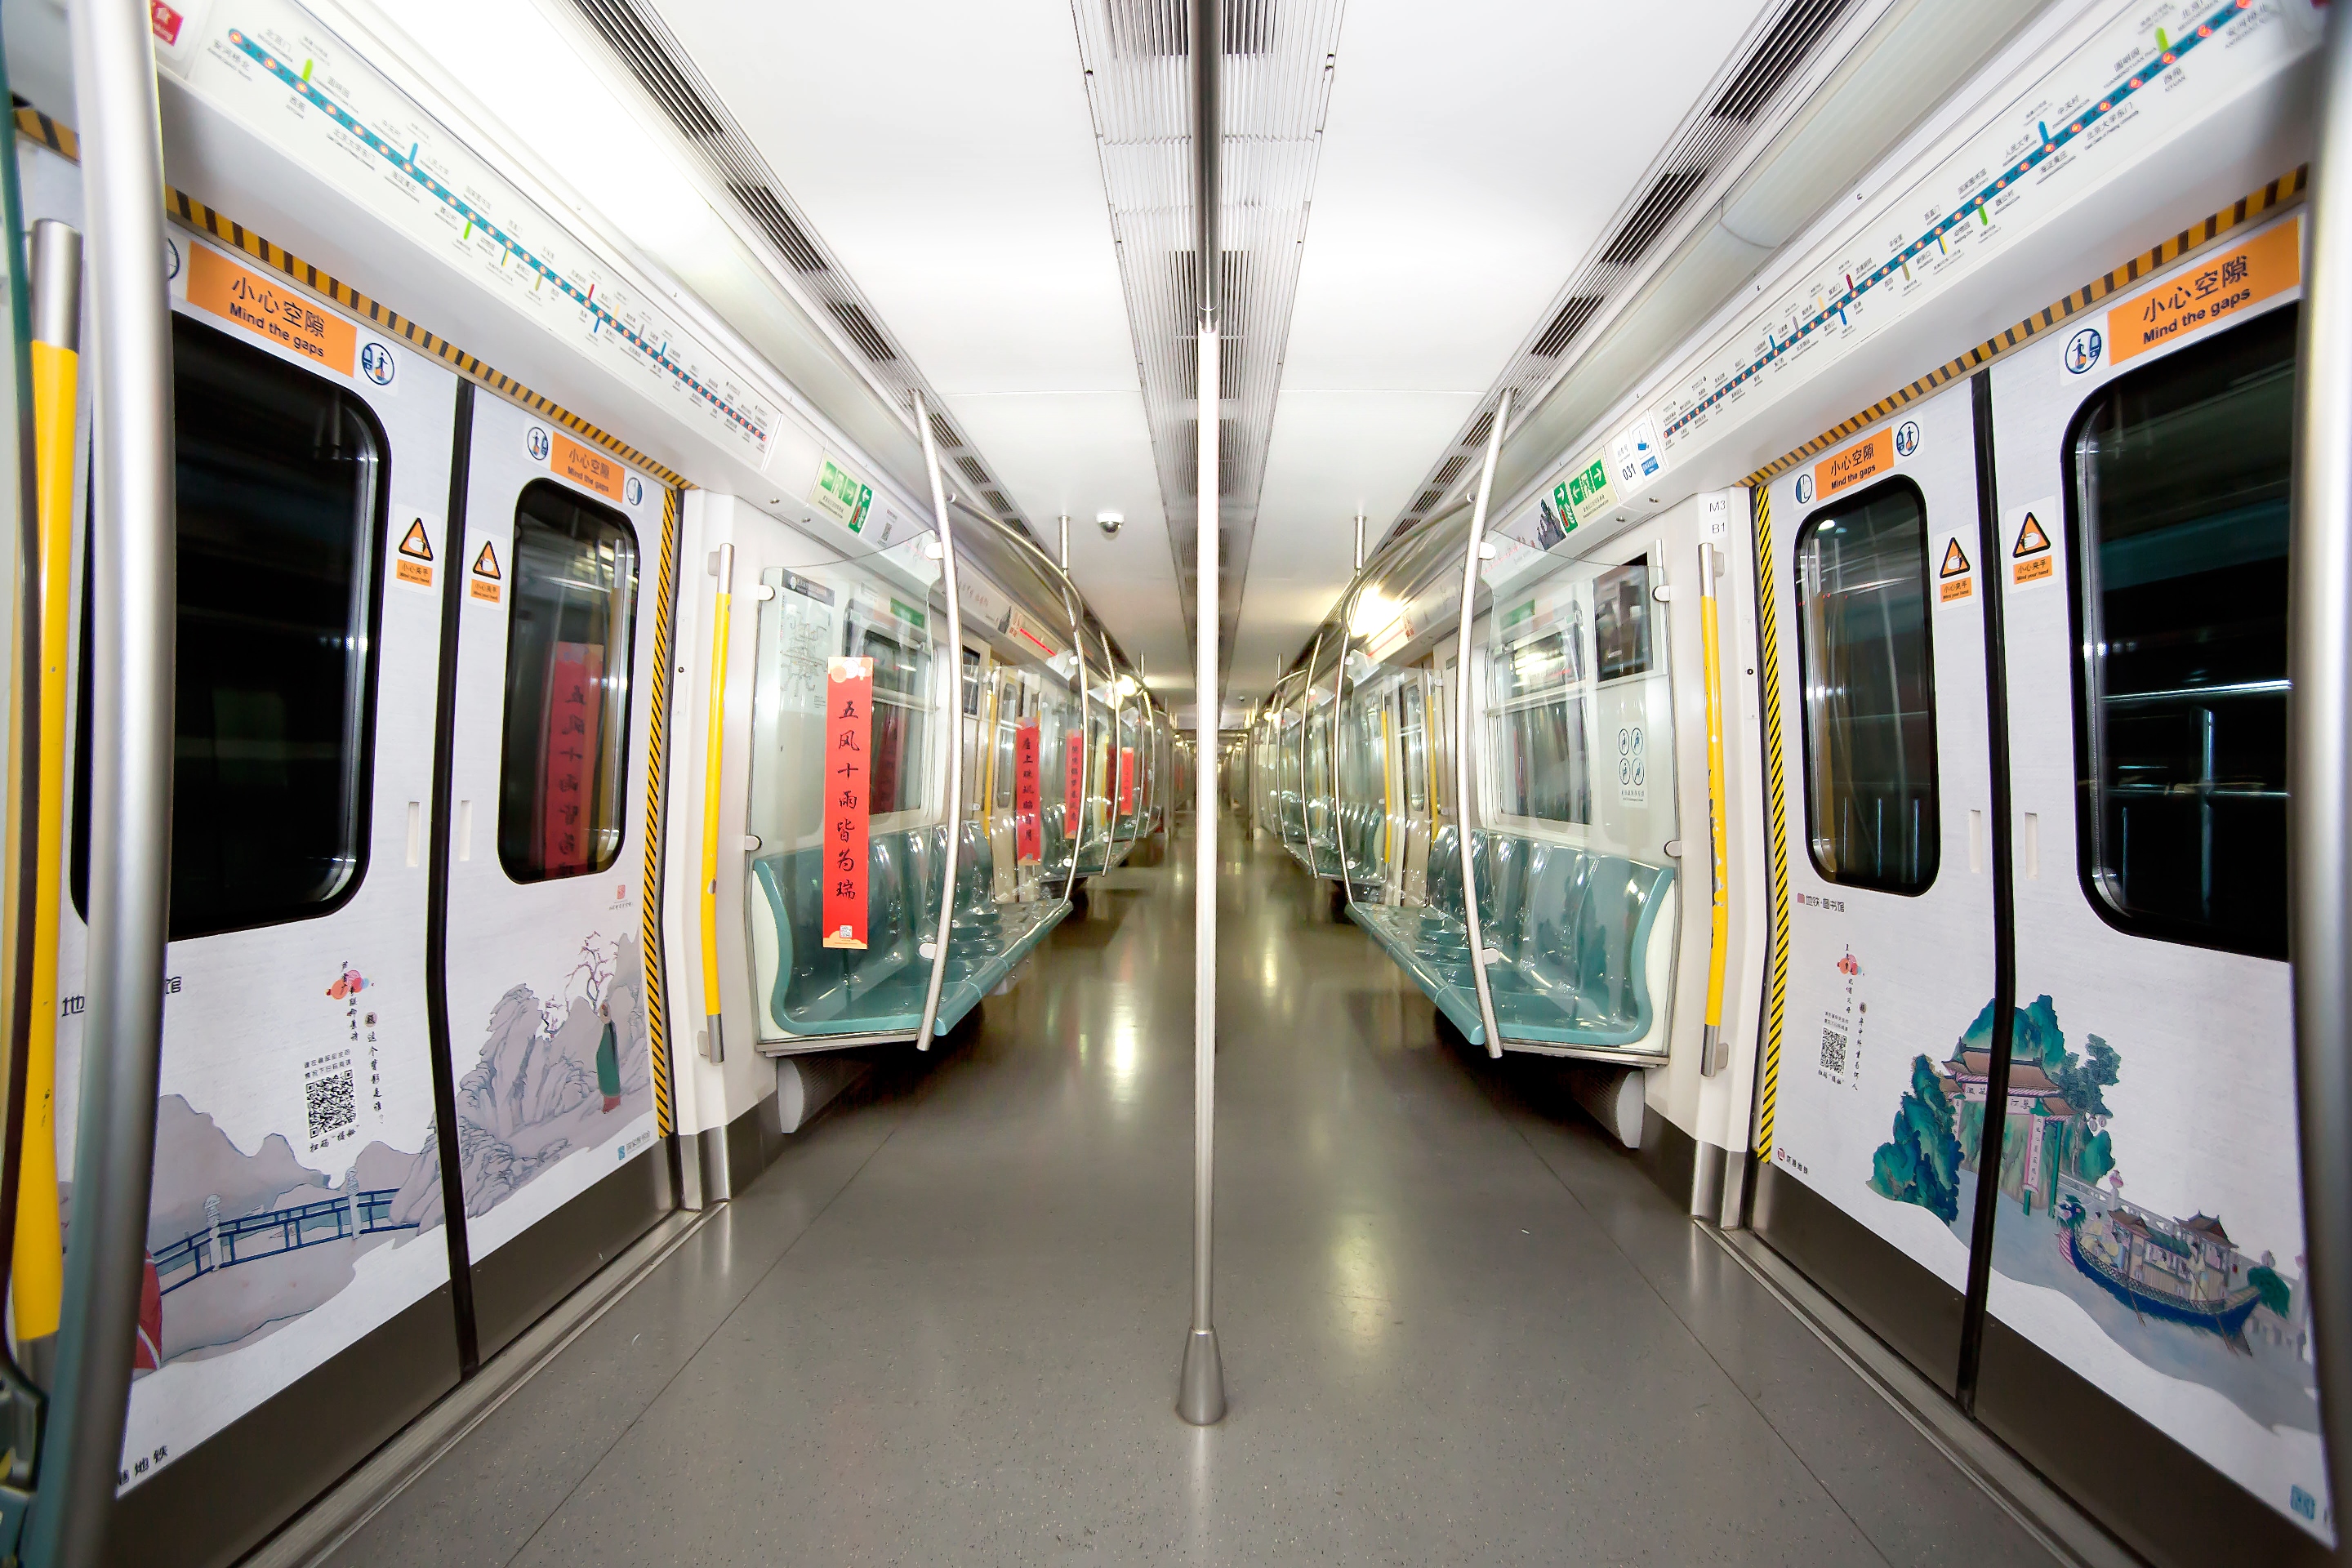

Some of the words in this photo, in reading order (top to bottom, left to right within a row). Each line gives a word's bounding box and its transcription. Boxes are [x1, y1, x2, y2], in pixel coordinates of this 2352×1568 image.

[2143, 255, 2248, 322] 小心空隙
[231, 276, 325, 340] 小心空隙
[2143, 318, 2178, 345] Mind
[2181, 310, 2206, 326] the
[2211, 287, 2251, 317] gaps
[229, 301, 265, 330] Mind
[268, 322, 290, 342] the
[292, 335, 325, 359] gaps
[567, 466, 583, 480] Mind
[584, 474, 594, 485] the
[568, 448, 610, 480] 小心空隙
[1622, 462, 1637, 481] 031
[1830, 443, 1874, 476] 小心空隙
[1831, 475, 1846, 490] Mind
[1860, 464, 1876, 479] gaps
[1709, 500, 1726, 513] M3
[1712, 522, 1726, 534] B1
[835, 700, 860, 900] 五风十雨皆为瑞
